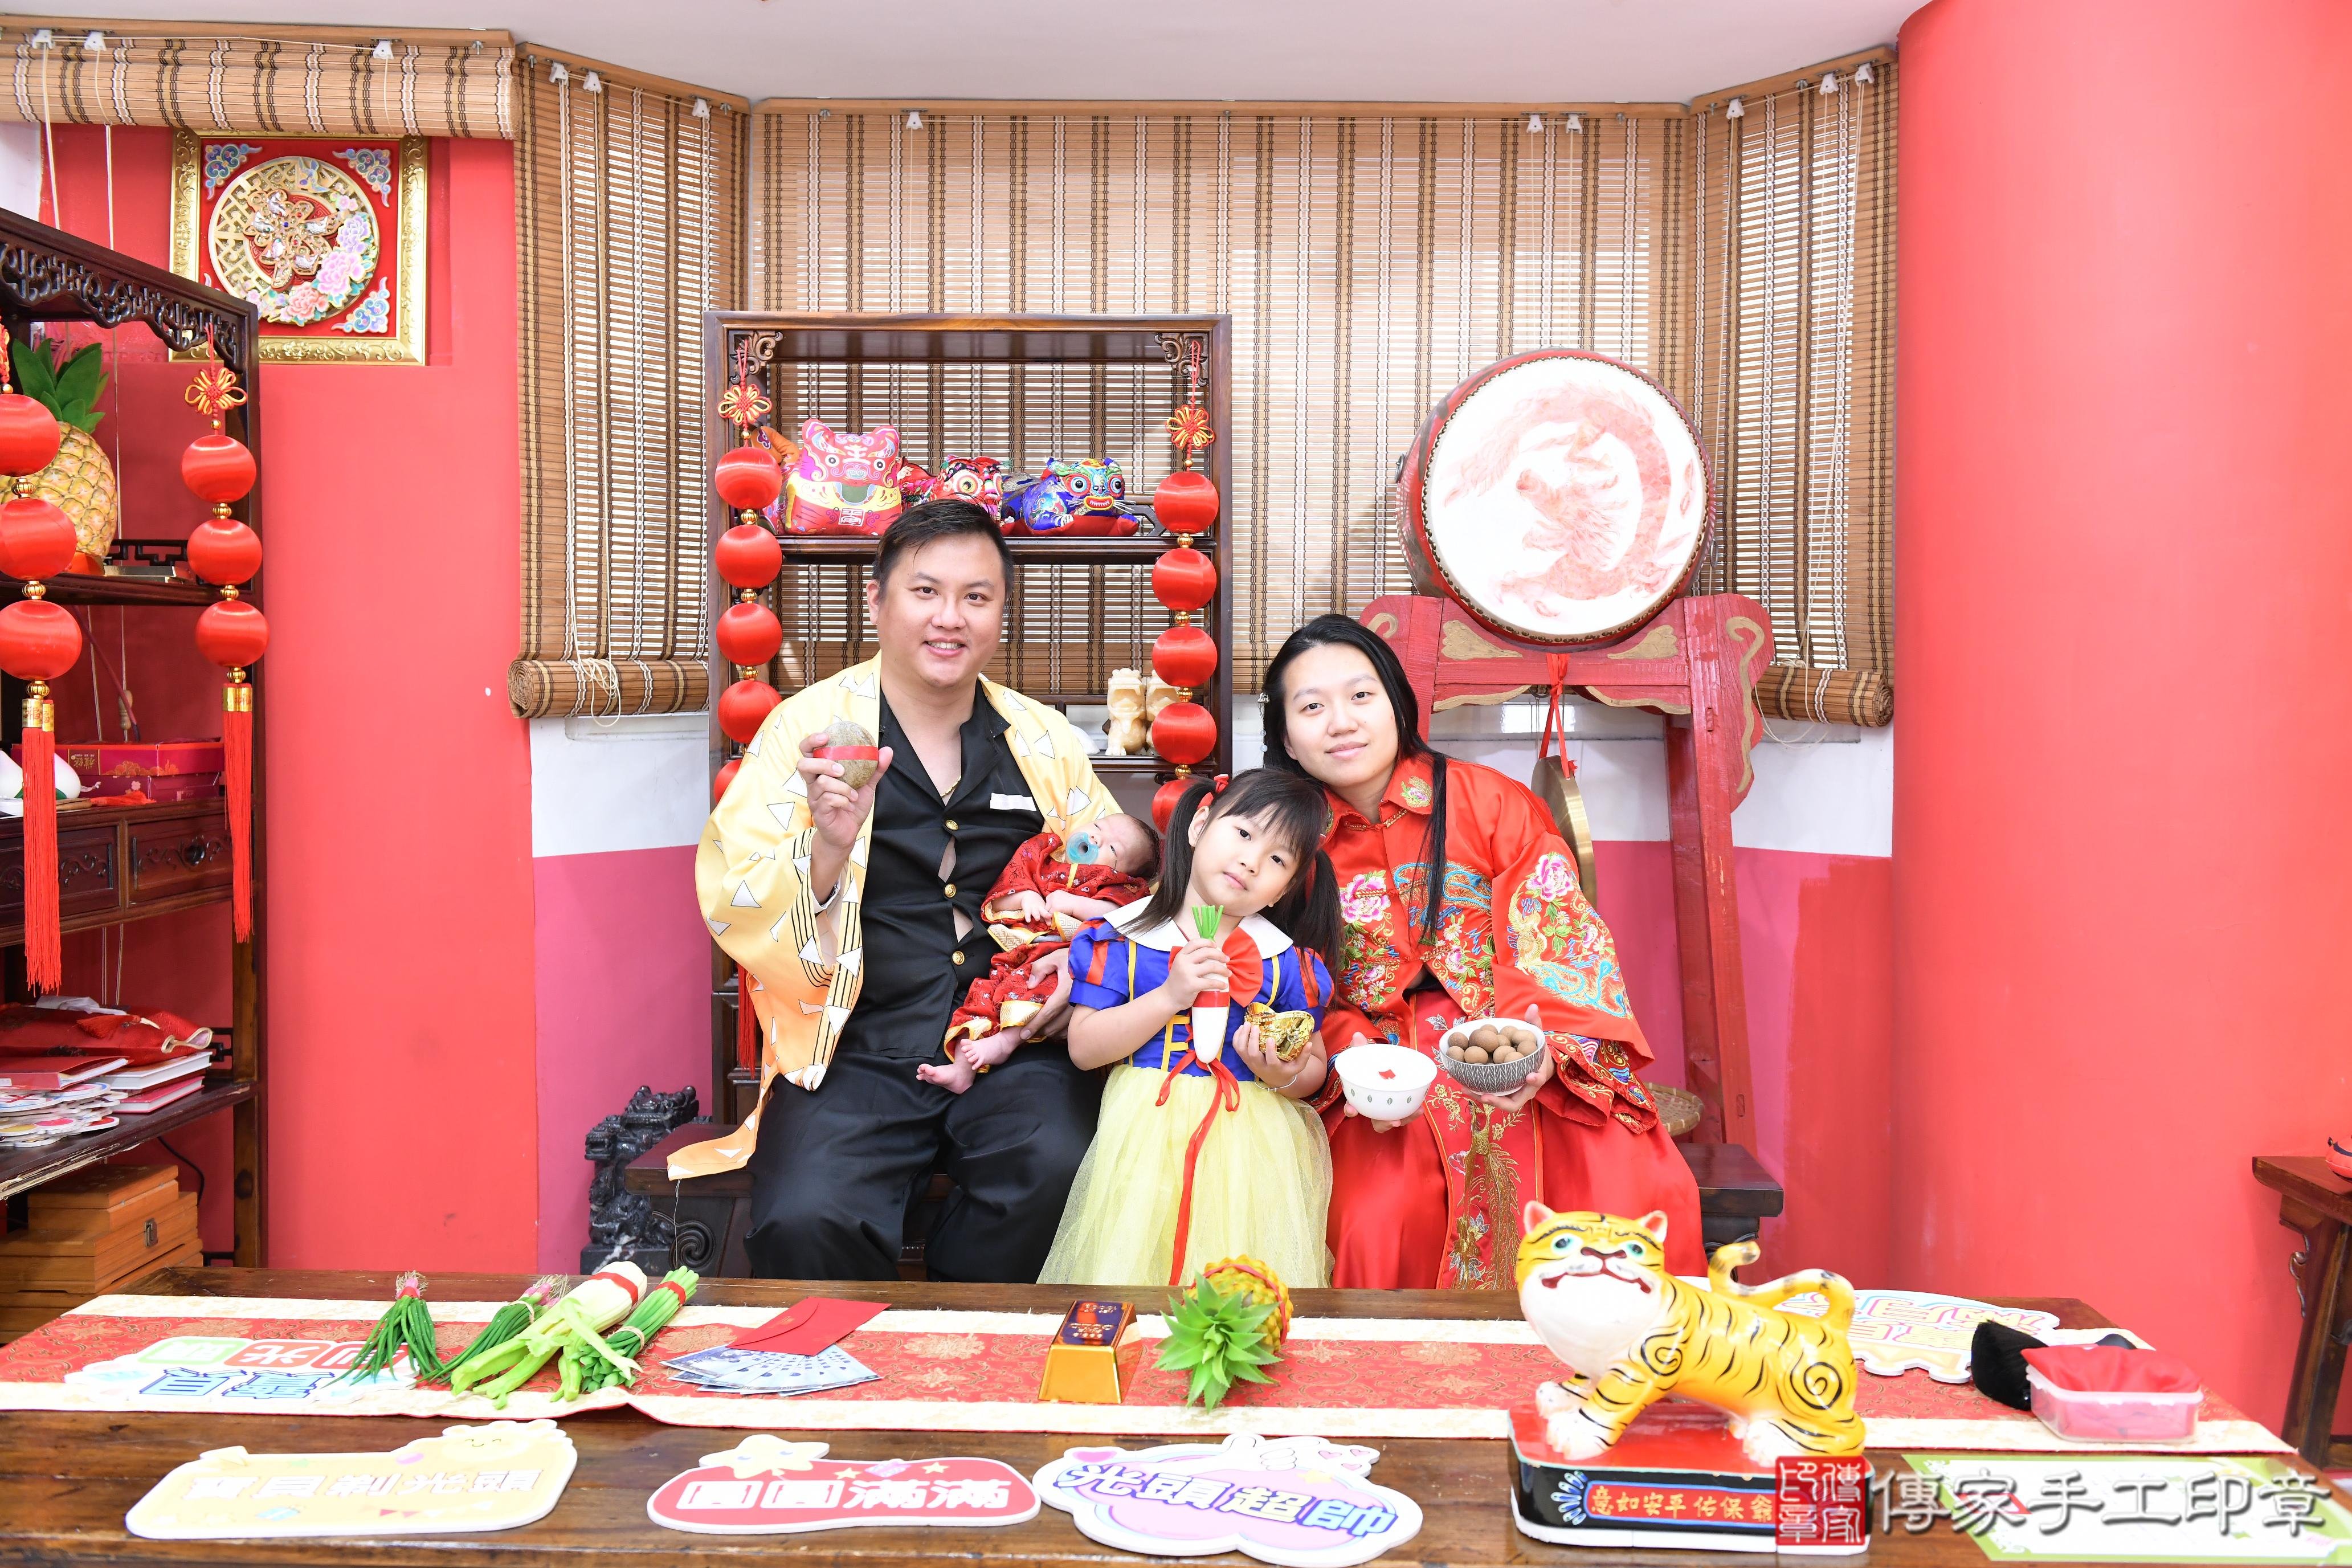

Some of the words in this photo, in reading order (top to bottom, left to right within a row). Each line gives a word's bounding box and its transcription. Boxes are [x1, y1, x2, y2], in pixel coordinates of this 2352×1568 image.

[139, 1367, 335, 1399] 寶貝
[183, 1469, 544, 1501] 寶貝剃光頭
[676, 1479, 1012, 1511] 圓圓滿滿
[1053, 1465, 1398, 1538] 光頭超帥
